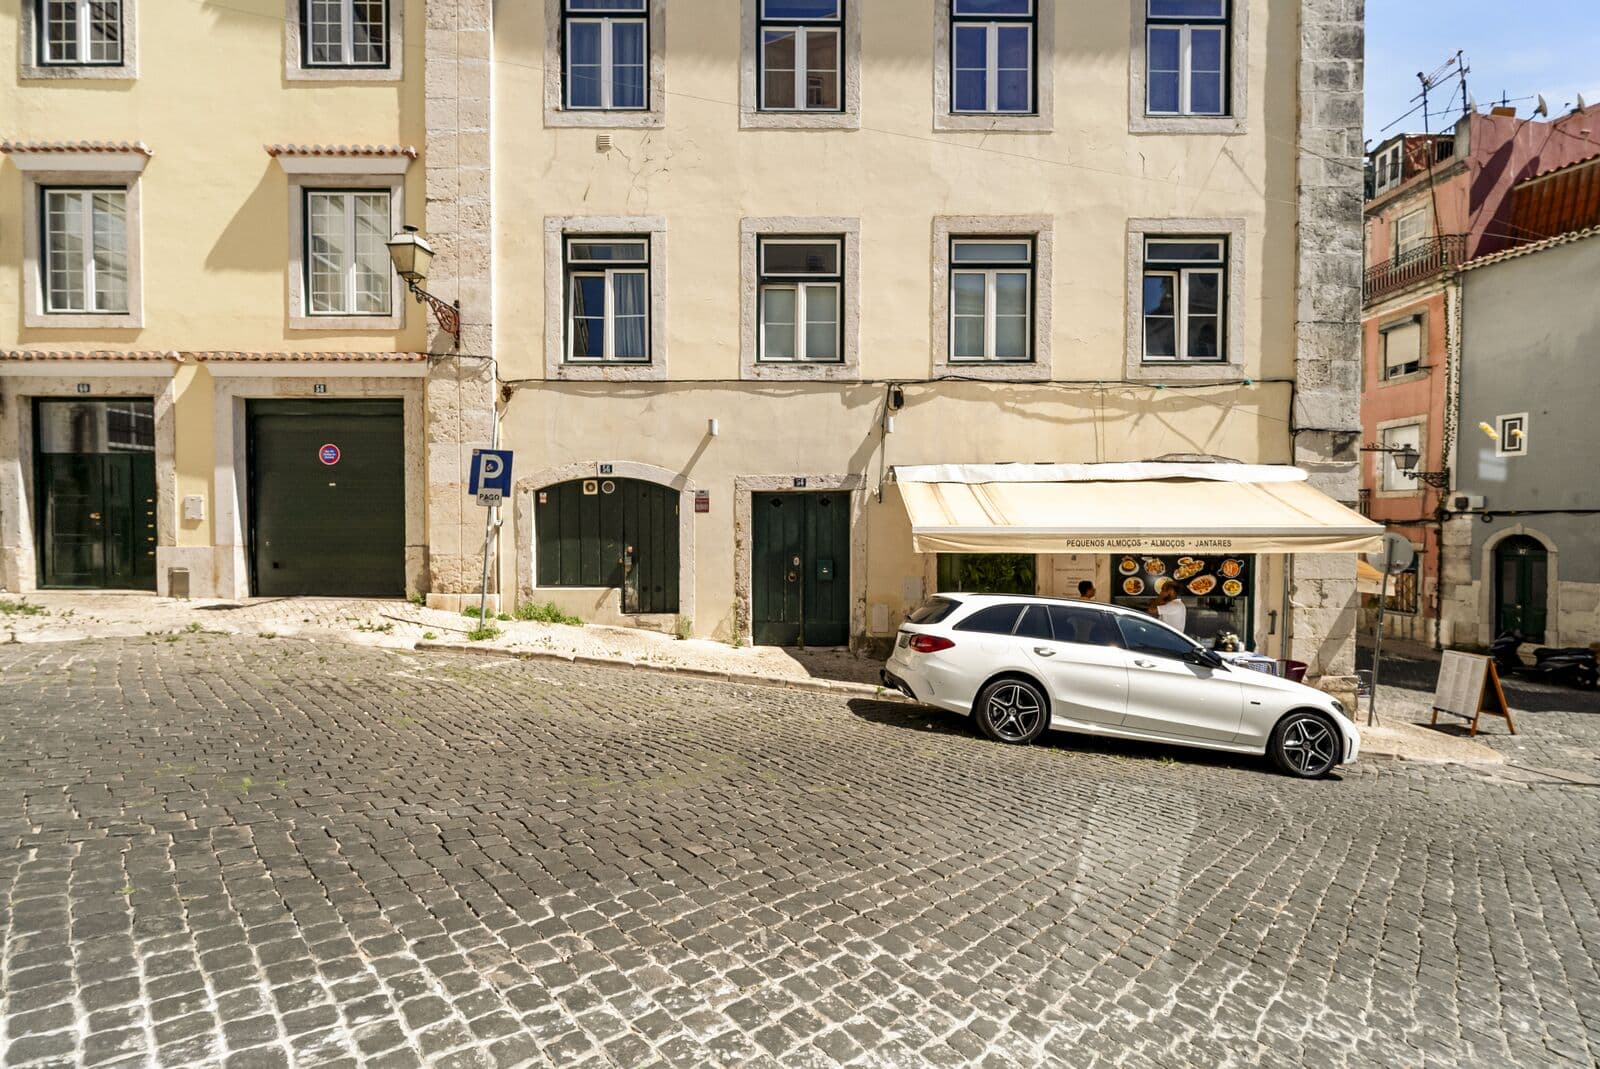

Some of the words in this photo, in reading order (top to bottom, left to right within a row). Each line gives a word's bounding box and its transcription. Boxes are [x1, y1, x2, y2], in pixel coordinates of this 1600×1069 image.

[479, 454, 503, 489] P
[479, 493, 500, 501] PAGO
[1066, 539, 1105, 548] PEQUENOS
[1106, 539, 1142, 548] ALMOÇOS
[1151, 539, 1185, 549] ALMOÇOS
[1195, 539, 1232, 548] JANTARES
